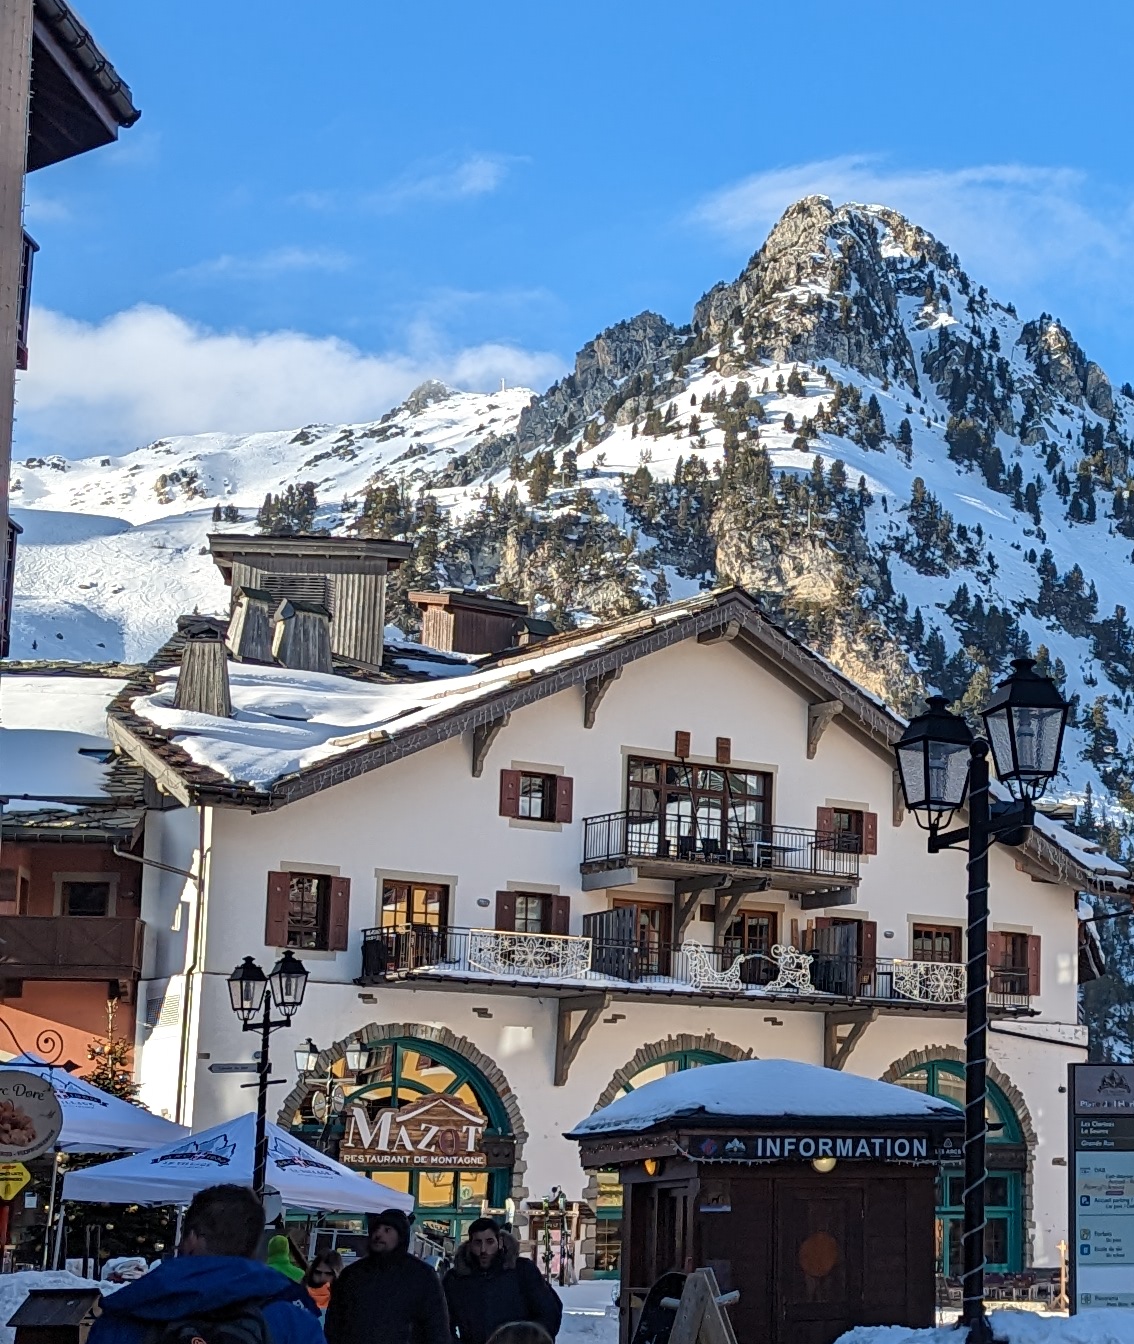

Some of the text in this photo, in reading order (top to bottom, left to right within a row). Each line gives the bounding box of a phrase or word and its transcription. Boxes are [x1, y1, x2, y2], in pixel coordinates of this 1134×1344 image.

[13, 1083, 44, 1101] Doré
[343, 1106, 482, 1156] MAZOT
[757, 1137, 927, 1157] INFORMATION
[343, 1155, 485, 1165] RESTAURANT DE MONTAGNE
